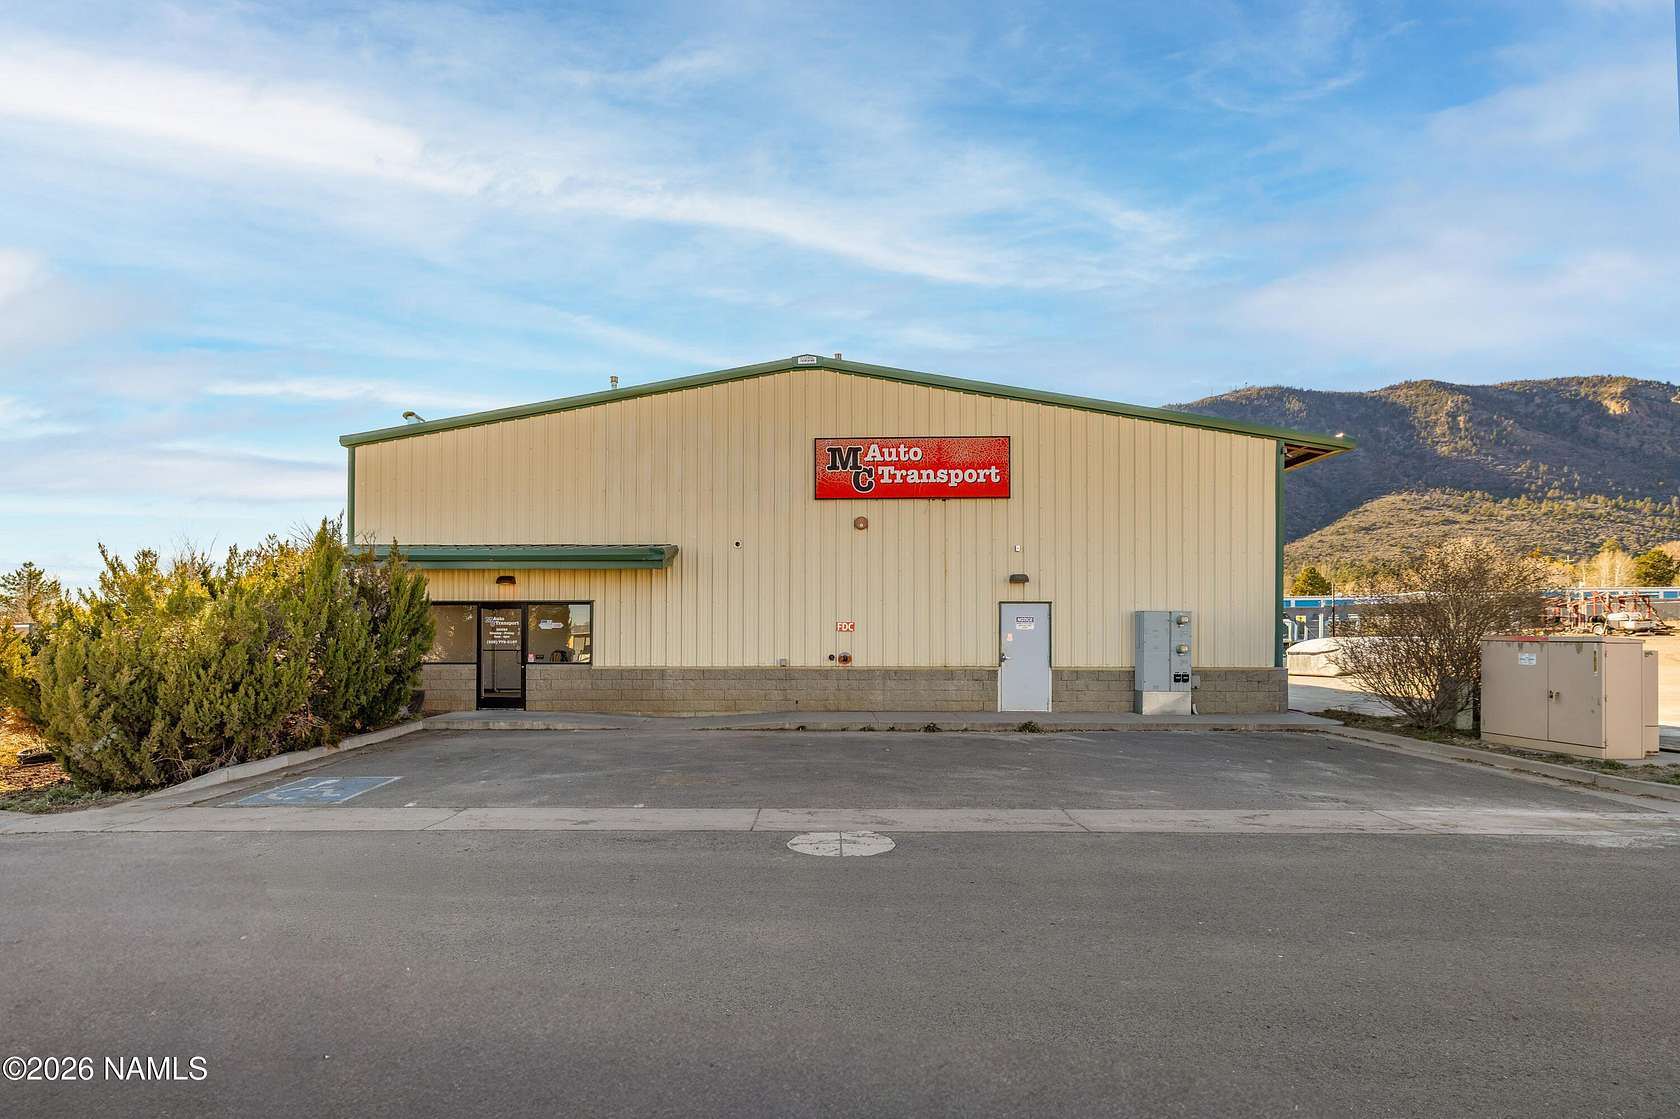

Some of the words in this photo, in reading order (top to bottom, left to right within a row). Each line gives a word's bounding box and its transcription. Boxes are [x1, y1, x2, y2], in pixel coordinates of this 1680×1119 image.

[864, 444, 923, 462] Auto
[878, 465, 1000, 487] Transport
[837, 622, 854, 631] FDC
